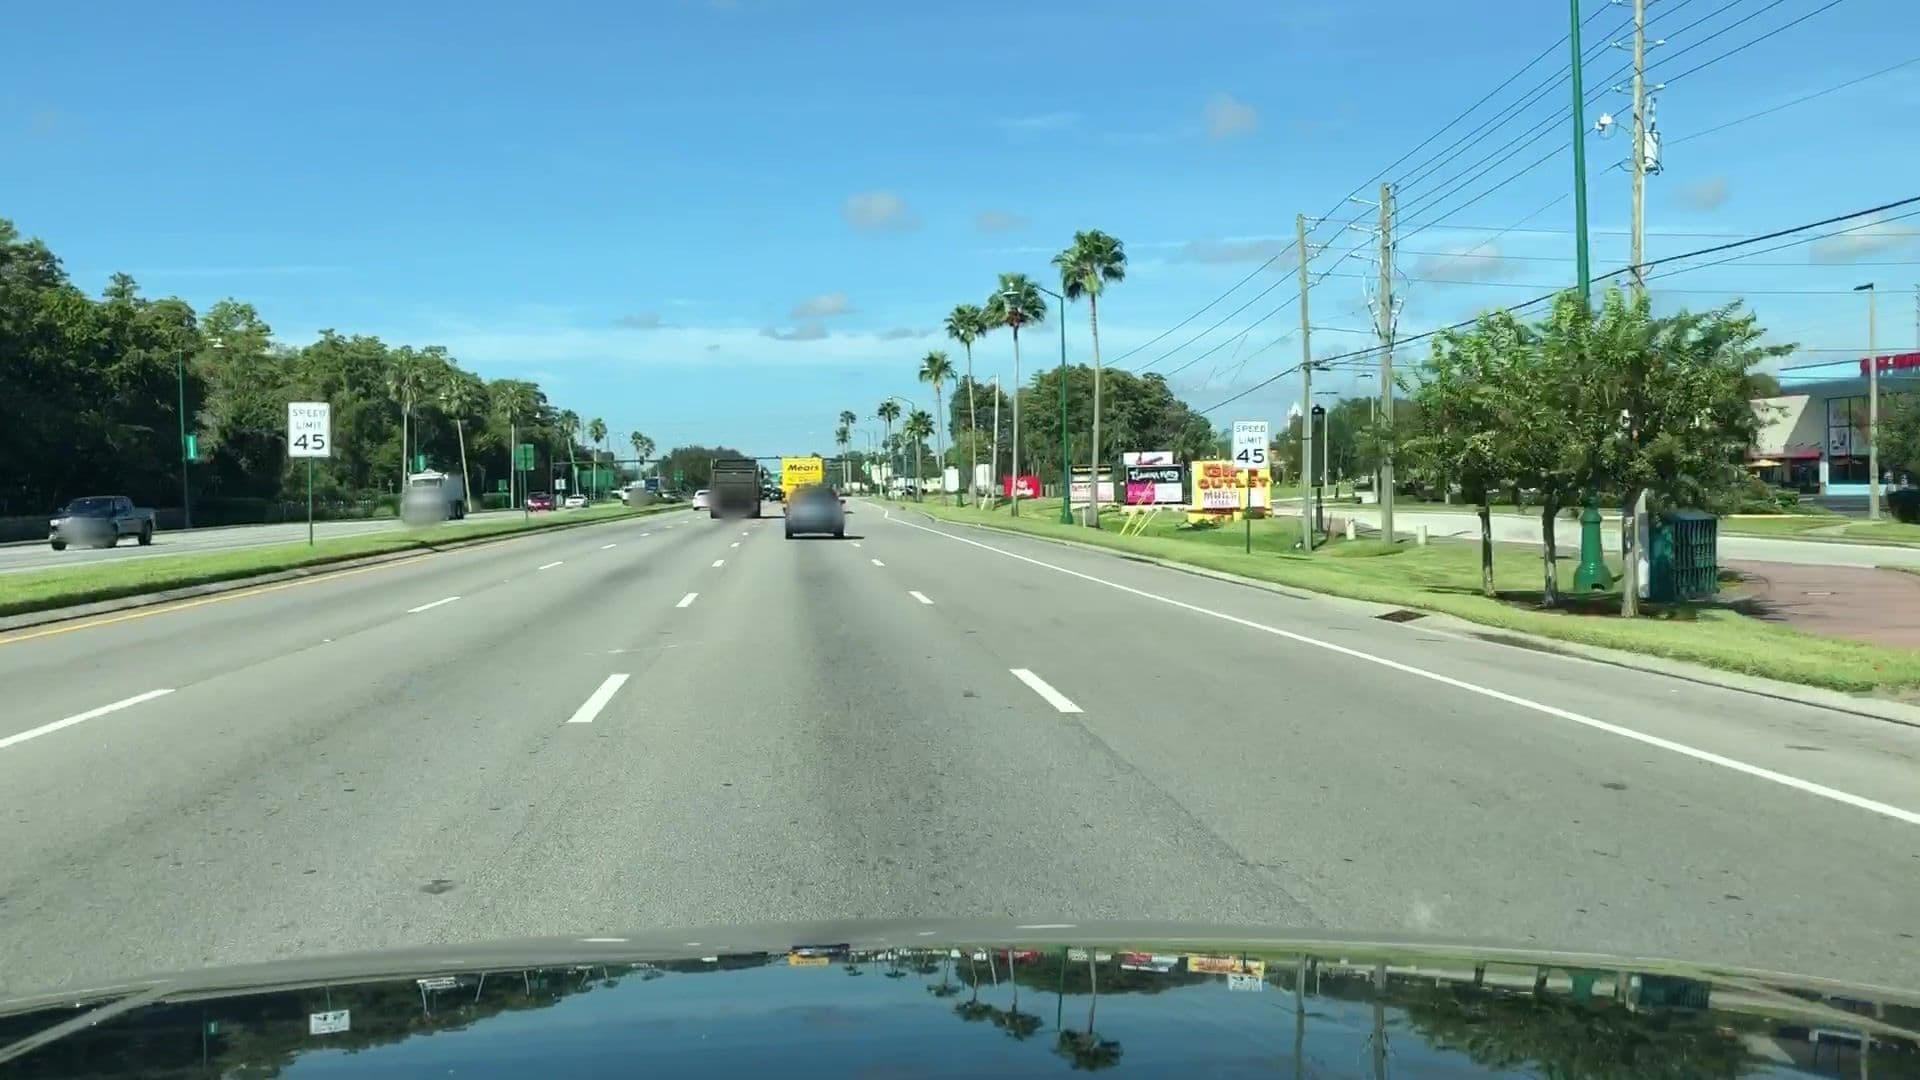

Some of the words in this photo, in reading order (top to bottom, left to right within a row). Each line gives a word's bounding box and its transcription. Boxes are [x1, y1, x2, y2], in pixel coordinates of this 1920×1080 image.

[292, 409, 326, 417] SPEED
[296, 421, 322, 430] LIMIT
[1236, 425, 1266, 433] SPEED
[293, 433, 325, 450] 45
[1239, 437, 1263, 445] LIMIT
[1236, 448, 1265, 464] 45
[1198, 478, 1269, 489] OUTLET
